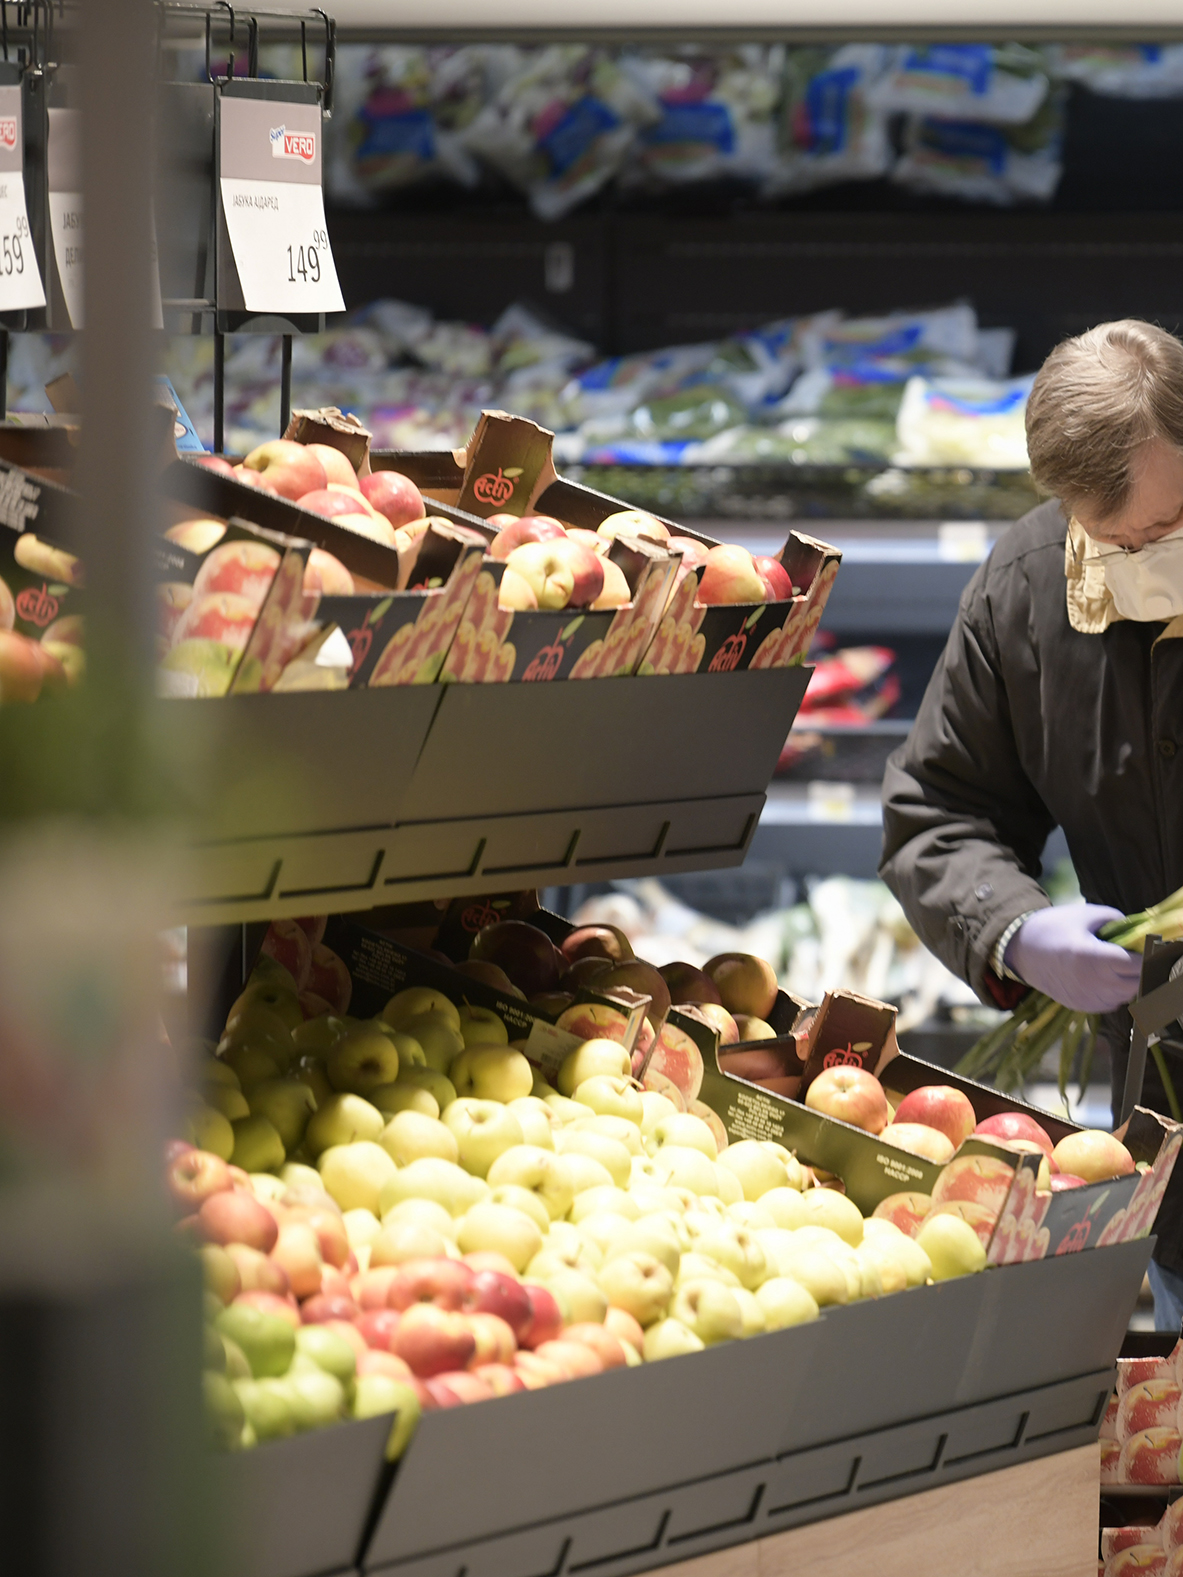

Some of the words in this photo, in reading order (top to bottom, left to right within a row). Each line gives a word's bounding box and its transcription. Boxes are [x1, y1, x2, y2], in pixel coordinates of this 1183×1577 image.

[0, 122, 15, 139] ERO
[285, 136, 313, 155] VERO
[232, 194, 253, 208] ЈАБУКА
[0, 235, 24, 276] 59
[287, 244, 321, 283] 149
[313, 229, 328, 250] 99
